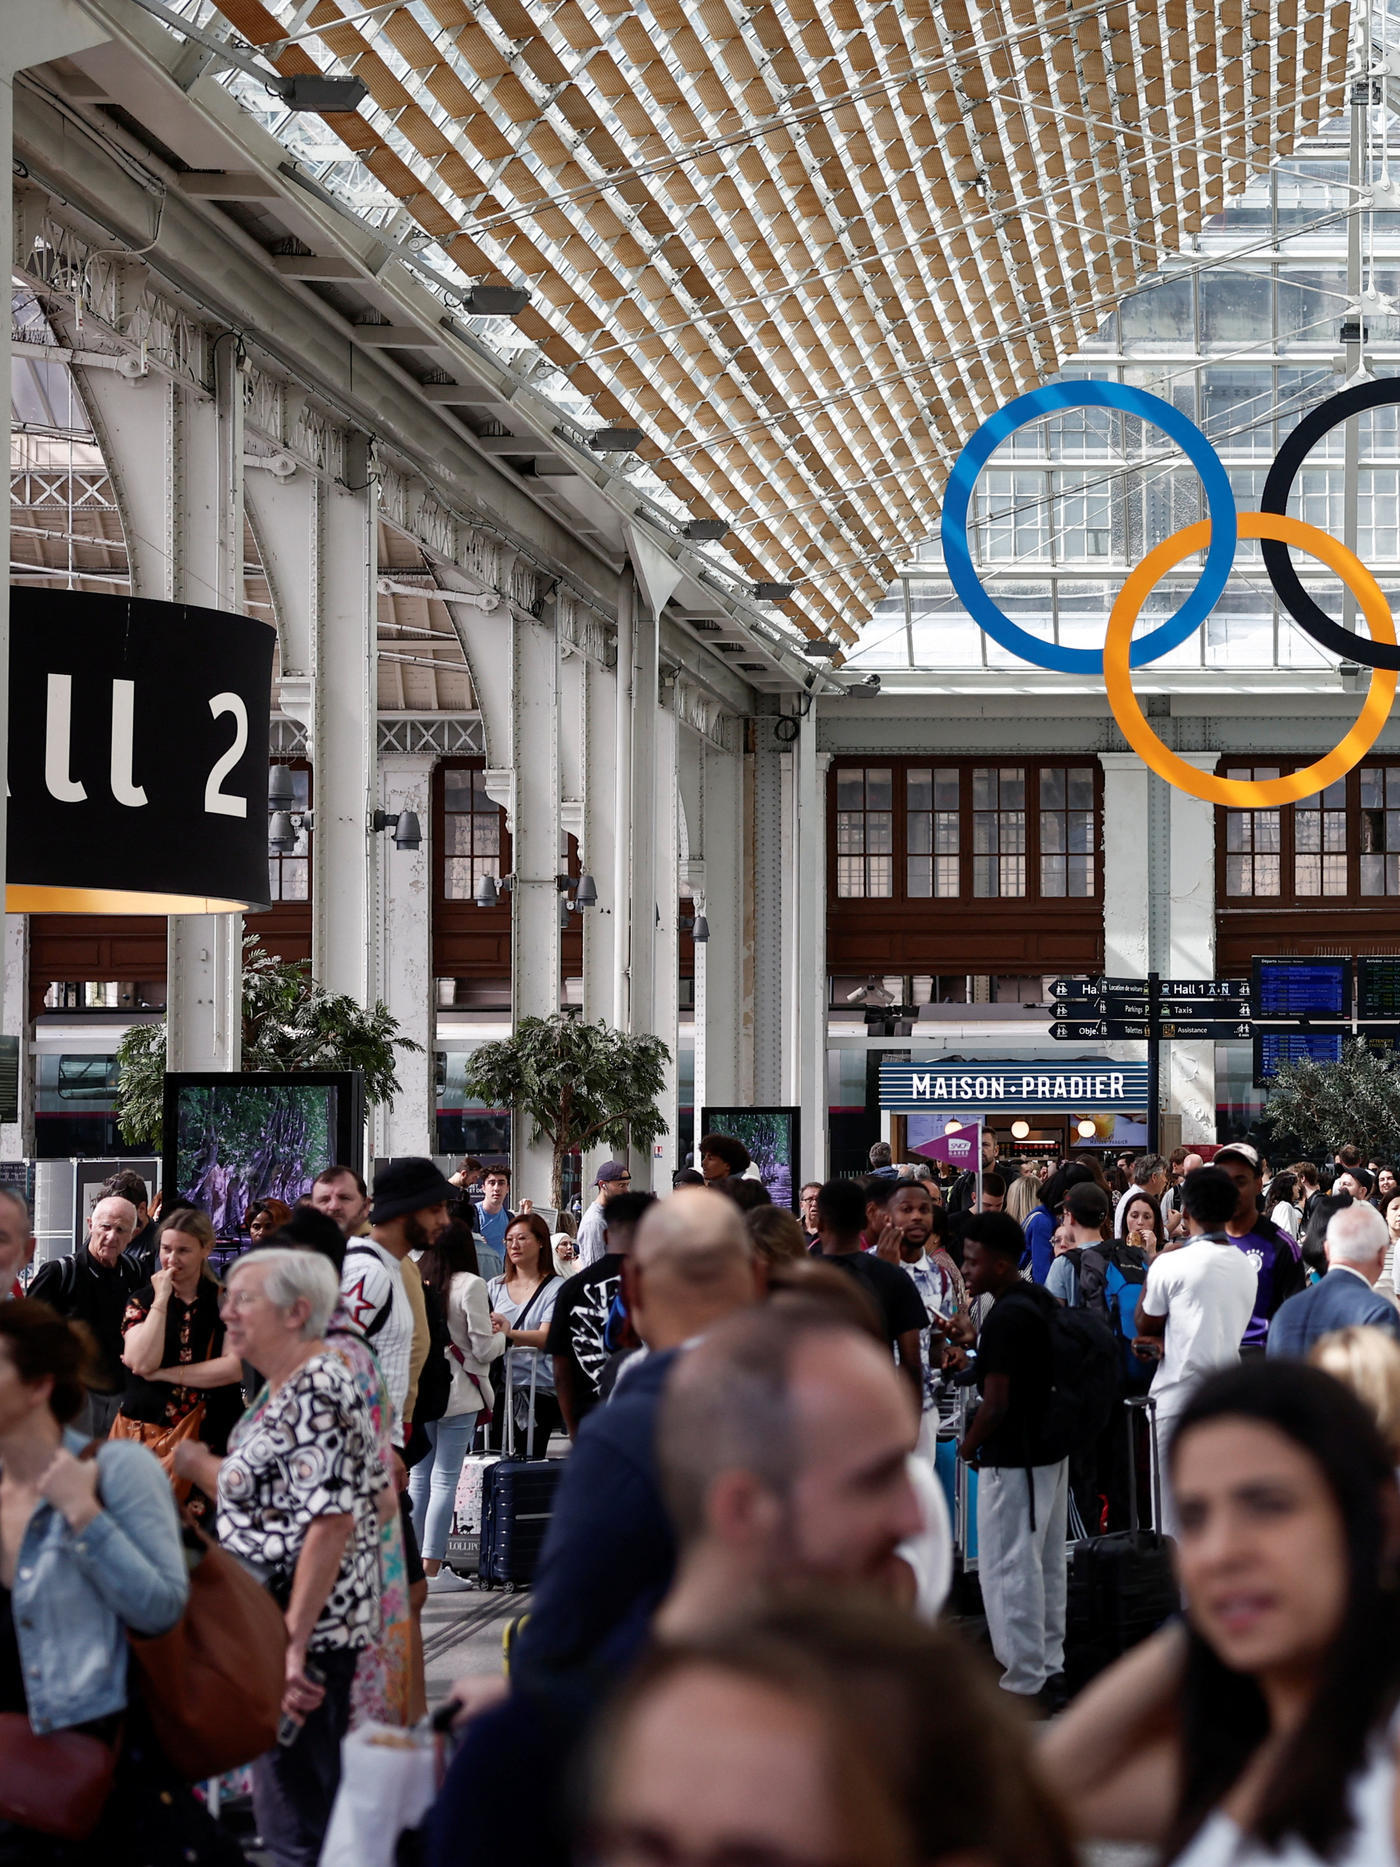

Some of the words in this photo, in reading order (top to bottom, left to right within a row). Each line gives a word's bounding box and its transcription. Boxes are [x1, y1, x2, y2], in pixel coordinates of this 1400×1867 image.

[7, 673, 149, 807] ll
[204, 692, 248, 819] 2
[1082, 984, 1100, 995] Ha
[1173, 984, 1196, 995] Hall
[1198, 984, 1204, 994] 1
[1208, 986, 1216, 994] A
[1221, 986, 1229, 994] N
[1124, 1005, 1143, 1014] Parkings
[1174, 1006, 1193, 1014] Taxis
[1078, 1027, 1099, 1037] Obje
[912, 1073, 1005, 1099] MAISON
[1022, 1072, 1125, 1099] PRADIER
